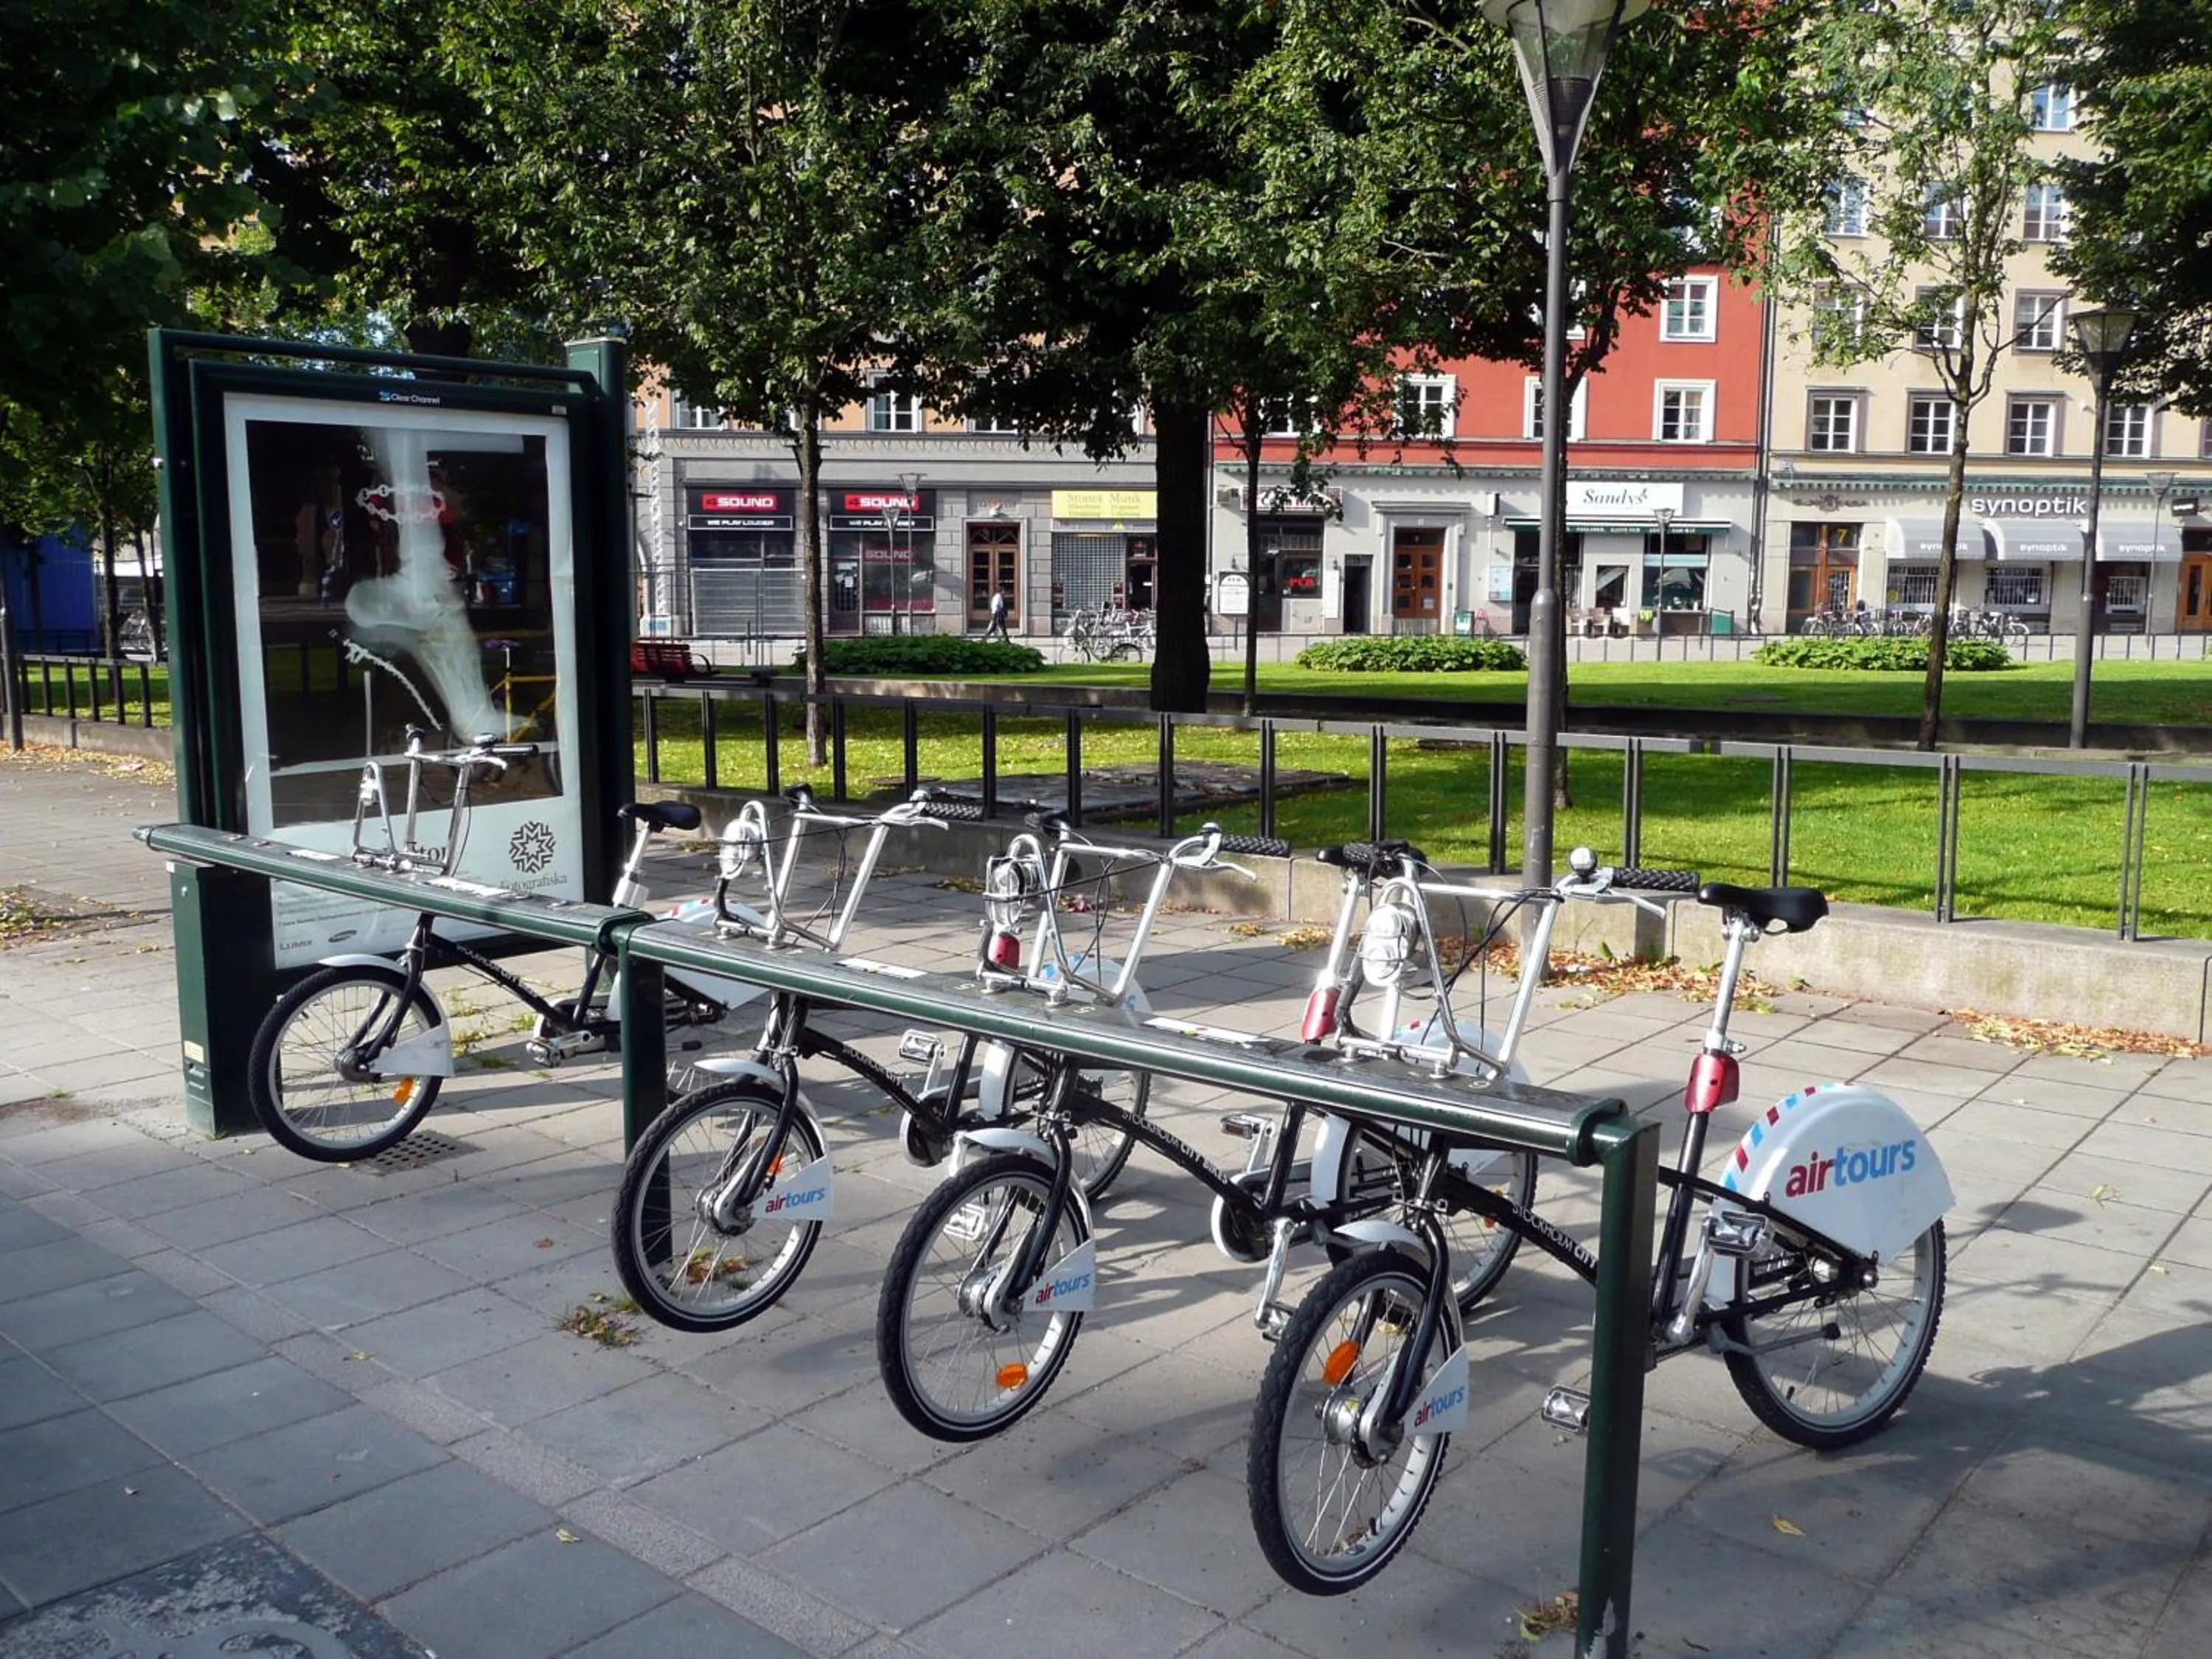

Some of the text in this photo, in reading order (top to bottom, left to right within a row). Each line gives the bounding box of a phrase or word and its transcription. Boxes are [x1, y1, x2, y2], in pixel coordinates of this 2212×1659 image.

[389, 393, 440, 406] Clear Channel
[1583, 489, 1644, 509] Sandys
[1971, 496, 2087, 517] synoptik
[1837, 529, 1847, 543] 7
[2019, 543, 2067, 554] synoptik
[1180, 1141, 1202, 1163] CITY
[1785, 1140, 1916, 1197] airtours
[765, 1188, 826, 1213] airtours
[1512, 1203, 1599, 1269] STOCKHOLM CITY
[1035, 1273, 1091, 1304] airtours
[1414, 1386, 1464, 1427] airtours
